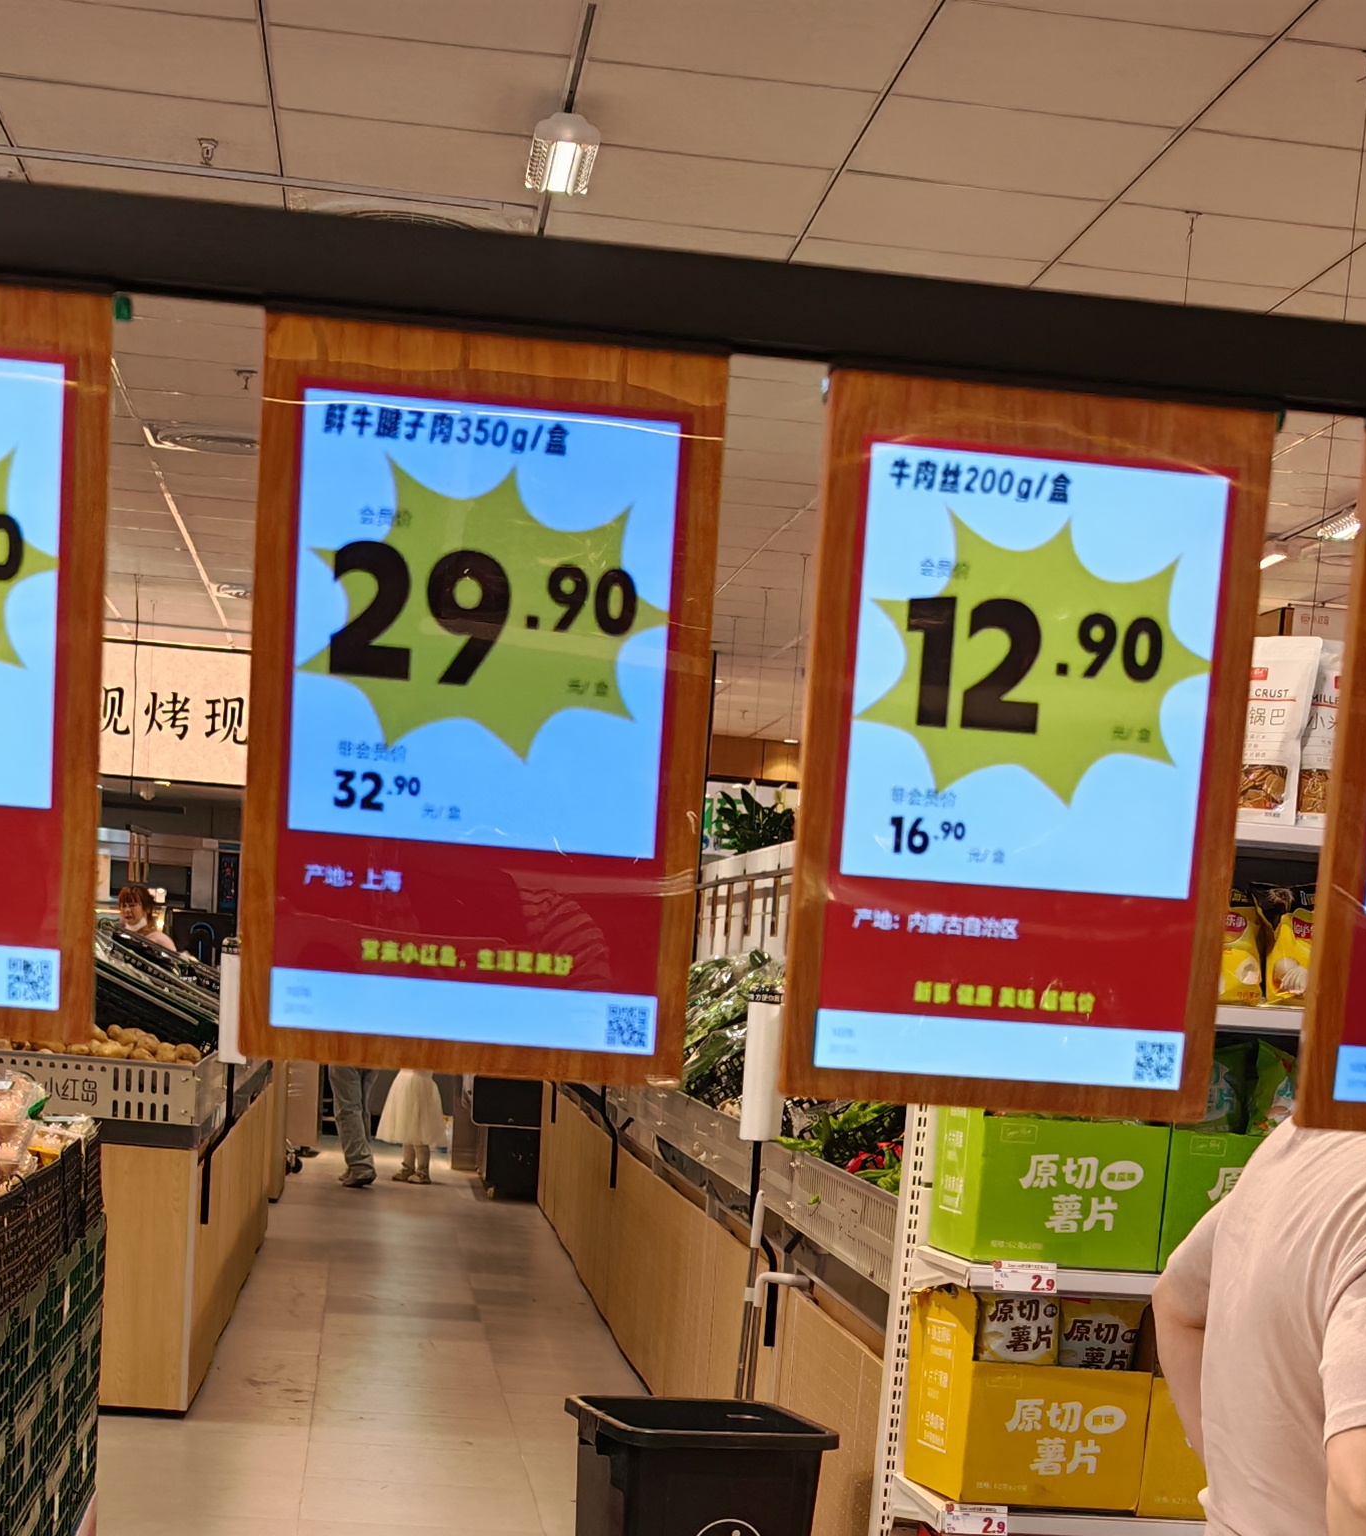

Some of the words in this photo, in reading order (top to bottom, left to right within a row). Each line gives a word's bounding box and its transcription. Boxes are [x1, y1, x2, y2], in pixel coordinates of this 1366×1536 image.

[889, 457, 1073, 504] 牛肉丝200g/盒
[329, 540, 638, 686] 29.90
[907, 596, 1164, 735] 12.90
[1254, 688, 1289, 698] CRUST
[1248, 707, 1285, 726] 锅巴
[333, 769, 421, 812] 32.90
[890, 815, 966, 855] 16.90
[44, 1076, 98, 1107] 小红岛
[1019, 1154, 1099, 1189] 原切
[1044, 1194, 1118, 1233] 薯片
[1031, 1274, 1056, 1291] 2.9
[989, 1298, 1040, 1323] 原切
[1006, 1325, 1054, 1352] 薯片
[1064, 1318, 1120, 1344] 原切
[1078, 1348, 1129, 1371] 薯片
[1004, 1398, 1083, 1433] 原切
[1029, 1438, 1101, 1476] 薯片
[982, 1517, 1006, 1535] 2.9
